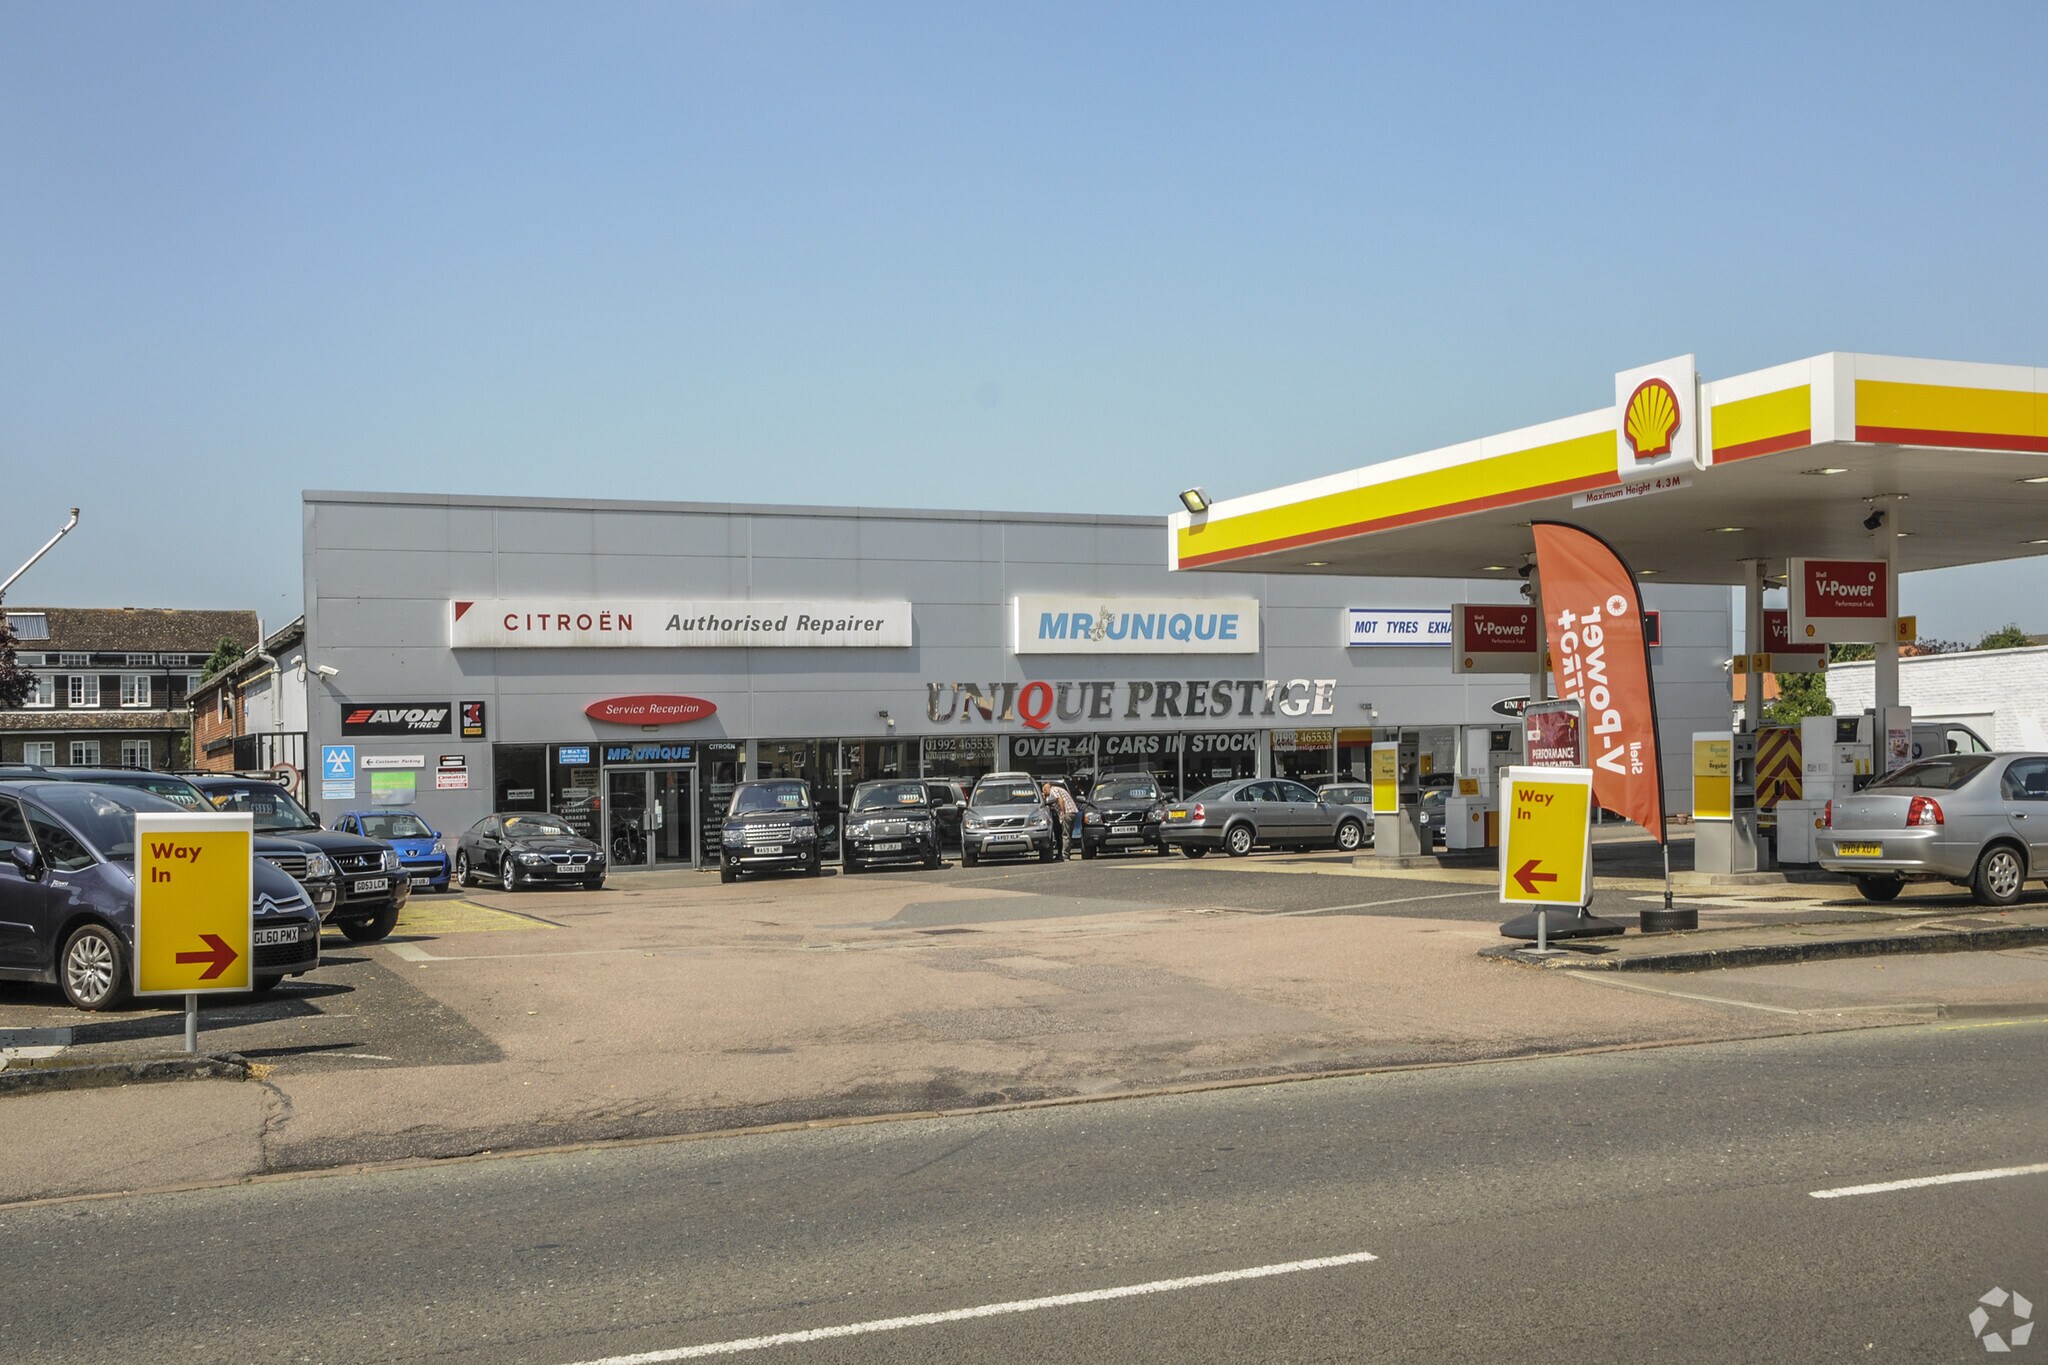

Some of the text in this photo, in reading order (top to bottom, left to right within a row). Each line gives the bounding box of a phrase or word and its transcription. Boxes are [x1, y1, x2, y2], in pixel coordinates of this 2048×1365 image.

[1586, 476, 1681, 503] Maximum Height 4.3M
[1816, 580, 1874, 596] V-Power
[504, 610, 884, 635] CITROËN Authorised Repairer
[1038, 612, 1239, 642] MR UNIQUE
[1354, 620, 1378, 634] MOT
[1386, 620, 1418, 634] TYRES
[1474, 622, 1525, 635] V-Power
[1900, 623, 1906, 635] 8
[1738, 659, 1743, 668] 4
[1757, 658, 1762, 667] 3
[605, 703, 699, 716] Service Reception
[926, 679, 1337, 730] UNIQUE PRESTIGE
[368, 708, 448, 723] AVON
[408, 721, 440, 729] TYRES
[1301, 731, 1332, 743] 465533
[925, 738, 995, 751] 01992 465533
[1014, 738, 1071, 757] OVER
[1076, 736, 1100, 755] 40
[1106, 735, 1160, 755] CARS
[1165, 735, 1187, 753] IN
[1192, 733, 1256, 752] STOCK
[607, 746, 691, 760] MR UNIQUE
[1532, 747, 1574, 760] PERFORMANCE
[1709, 763, 1728, 771] Regular
[279, 771, 290, 787] 5
[1518, 789, 1554, 806] Way
[1517, 807, 1531, 820] In
[151, 842, 202, 863] Way
[151, 866, 171, 883] In
[254, 928, 298, 945] GL60 PMX
